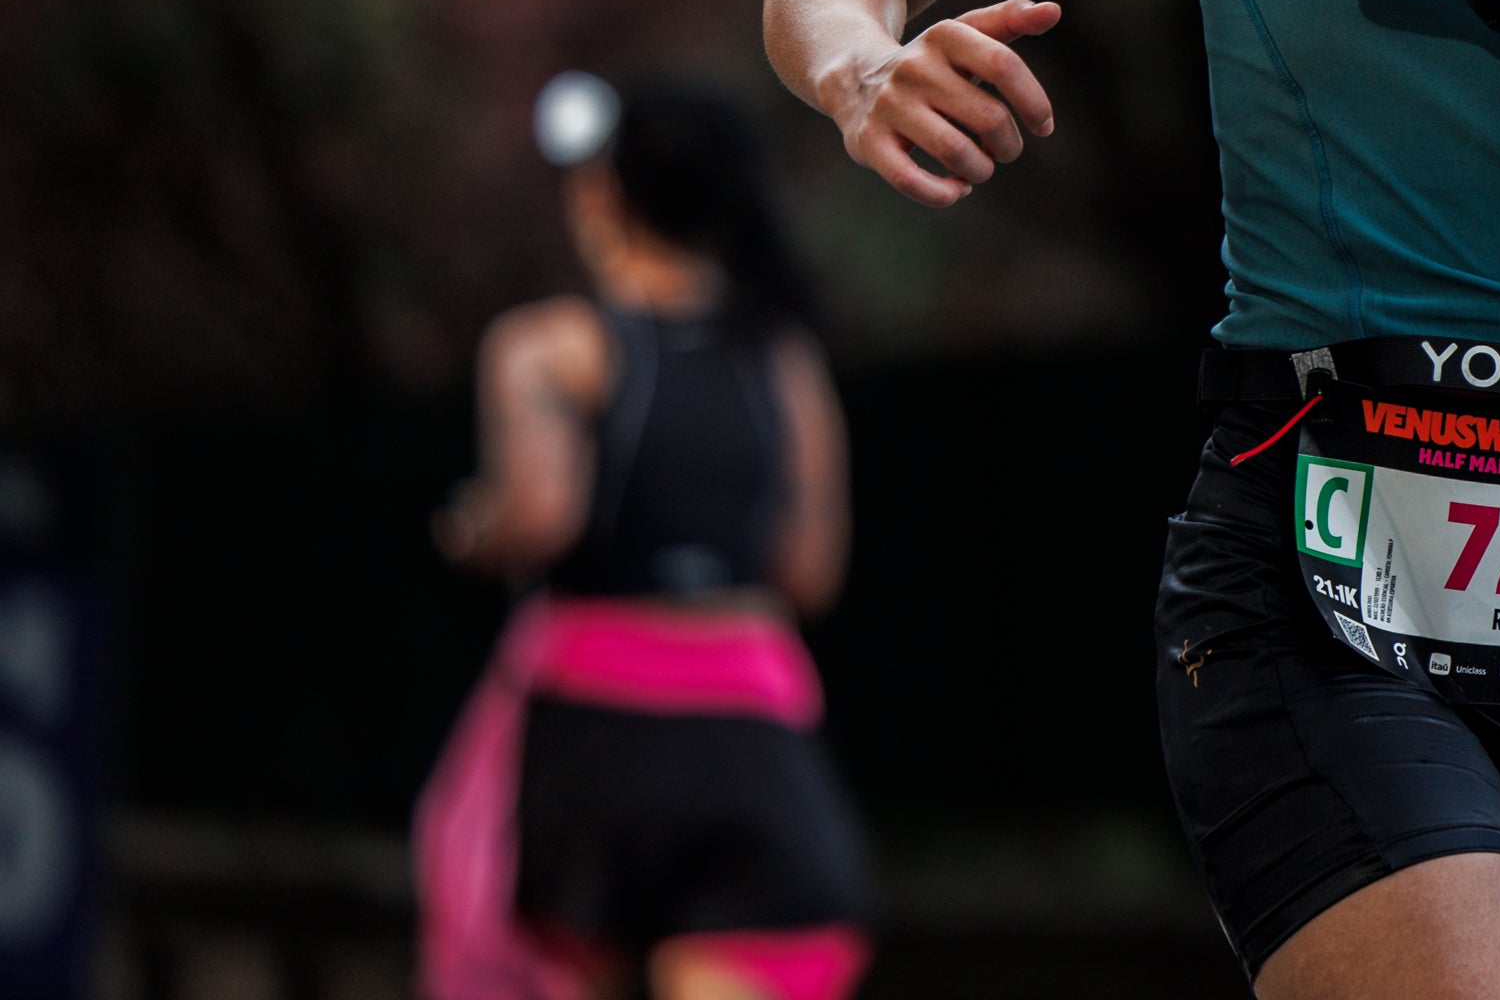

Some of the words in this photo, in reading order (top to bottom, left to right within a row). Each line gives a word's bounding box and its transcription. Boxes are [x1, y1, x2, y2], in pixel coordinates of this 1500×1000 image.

[1418, 447, 1466, 470] HALF
[1316, 476, 1349, 549] C
[1313, 575, 1359, 609] 21.1K
[1456, 666, 1487, 676] Uniclass
